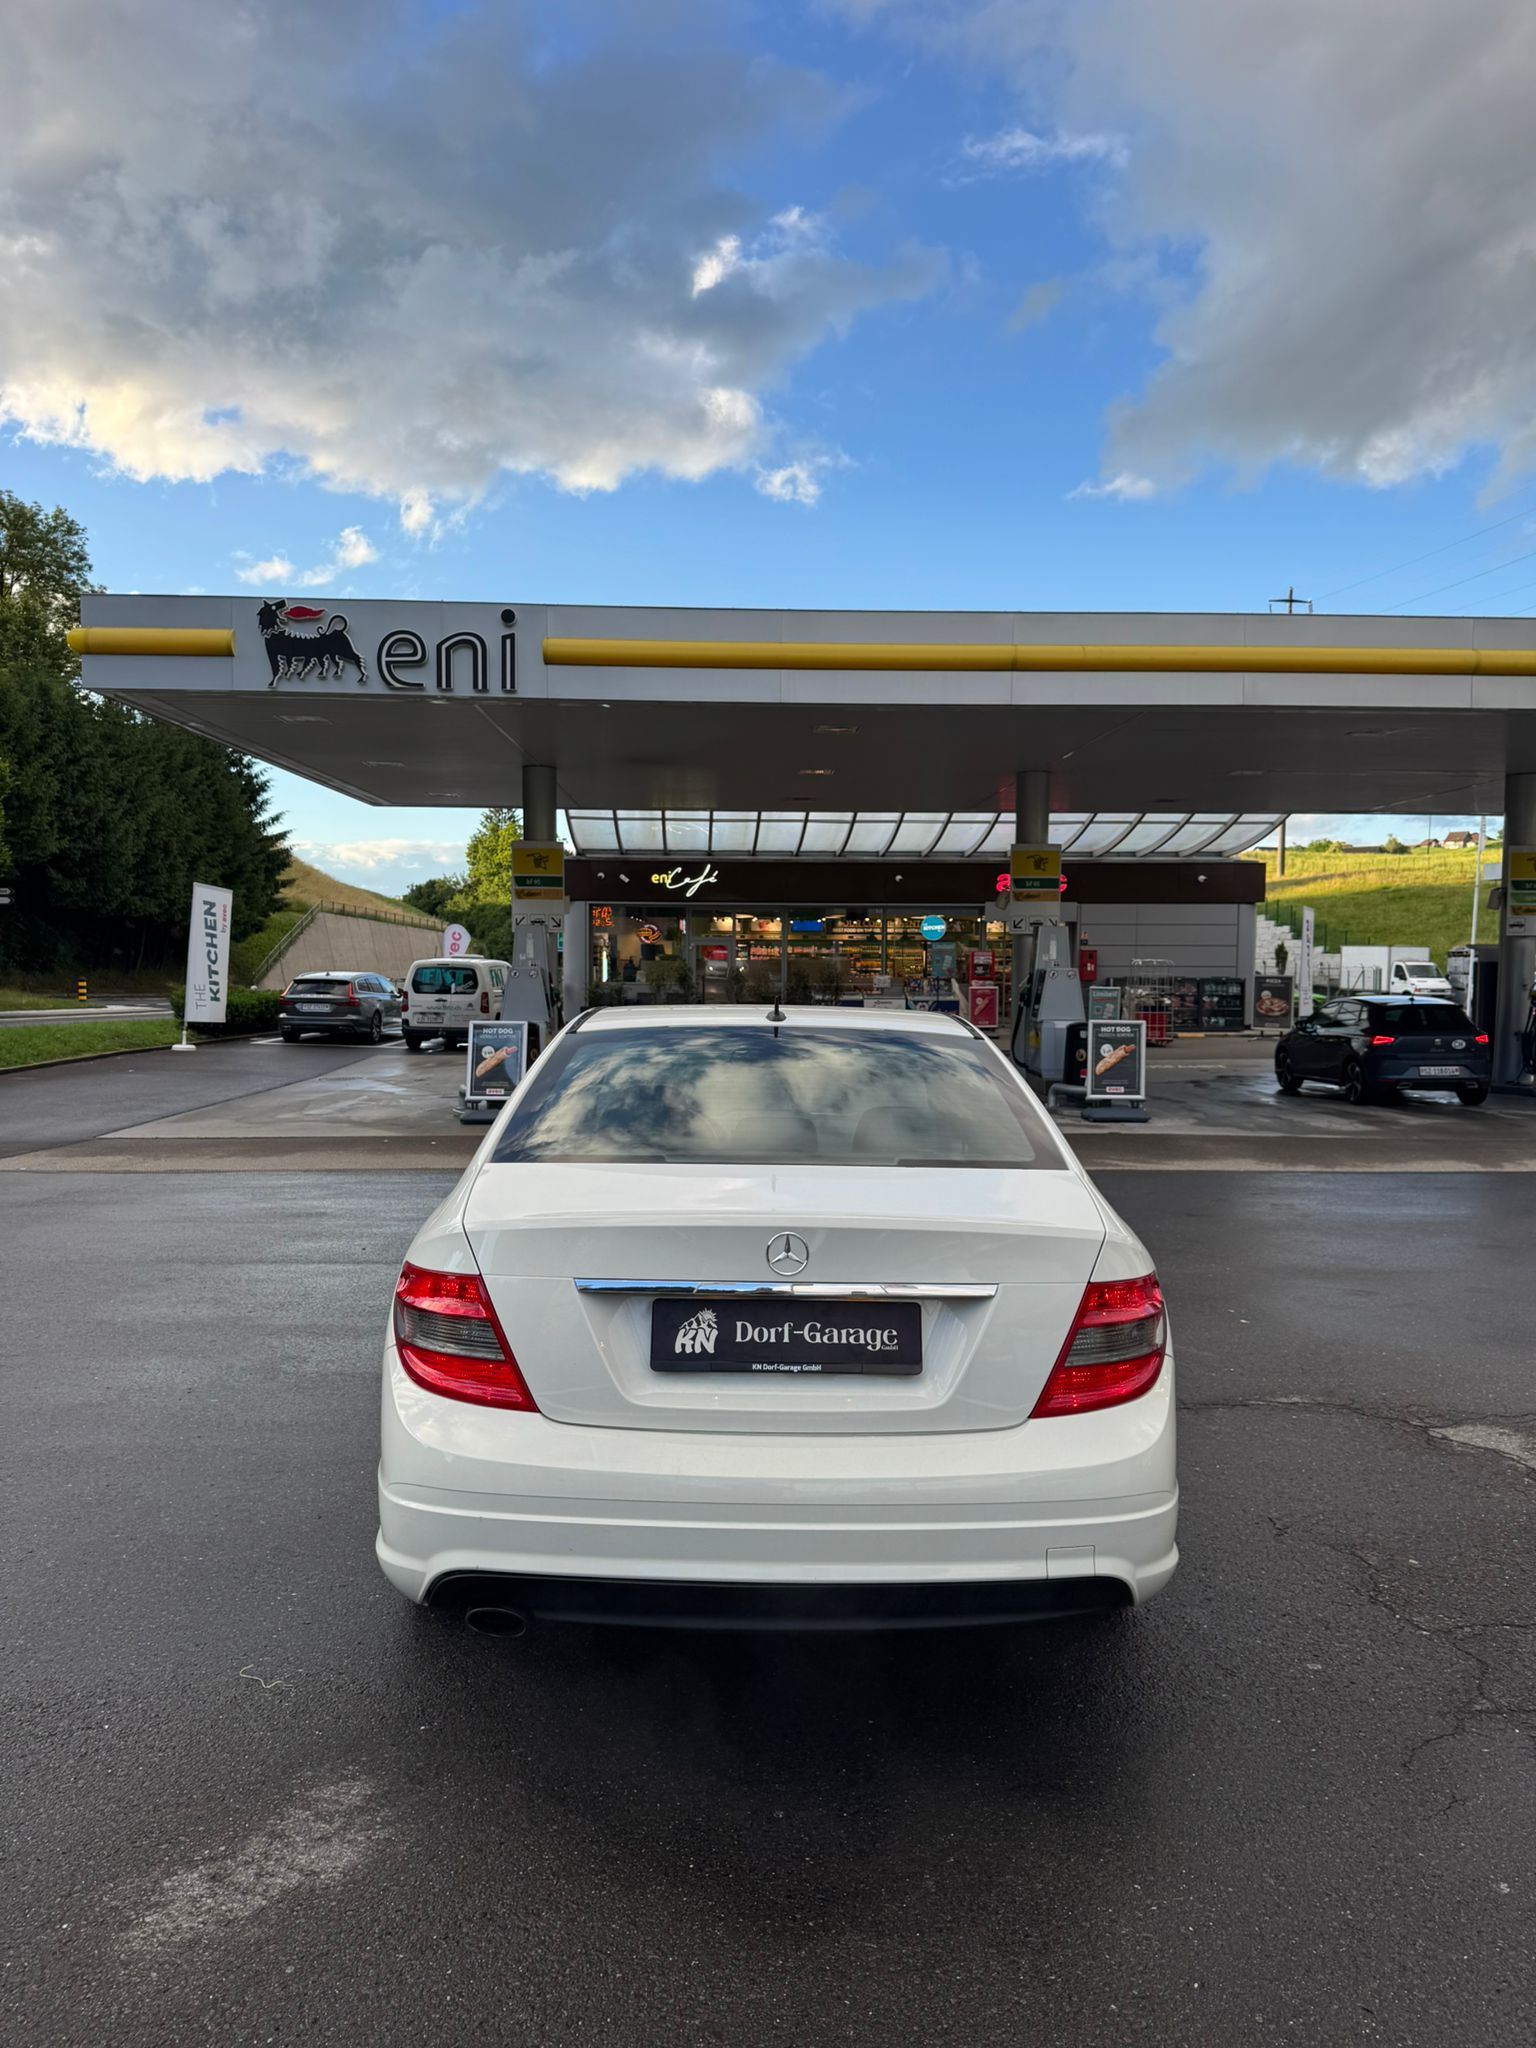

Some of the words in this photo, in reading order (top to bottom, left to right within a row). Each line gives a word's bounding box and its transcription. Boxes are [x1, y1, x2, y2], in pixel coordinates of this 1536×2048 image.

[377, 608, 516, 692] eni
[651, 871, 672, 884] eni
[666, 864, 719, 897] Café
[194, 984, 207, 1010] THE
[203, 900, 221, 1003] KITCHEN
[675, 1328, 718, 1354] KN
[735, 1321, 898, 1351] Dorf-Garage
[763, 1364, 801, 1372] Dorf-Garage
